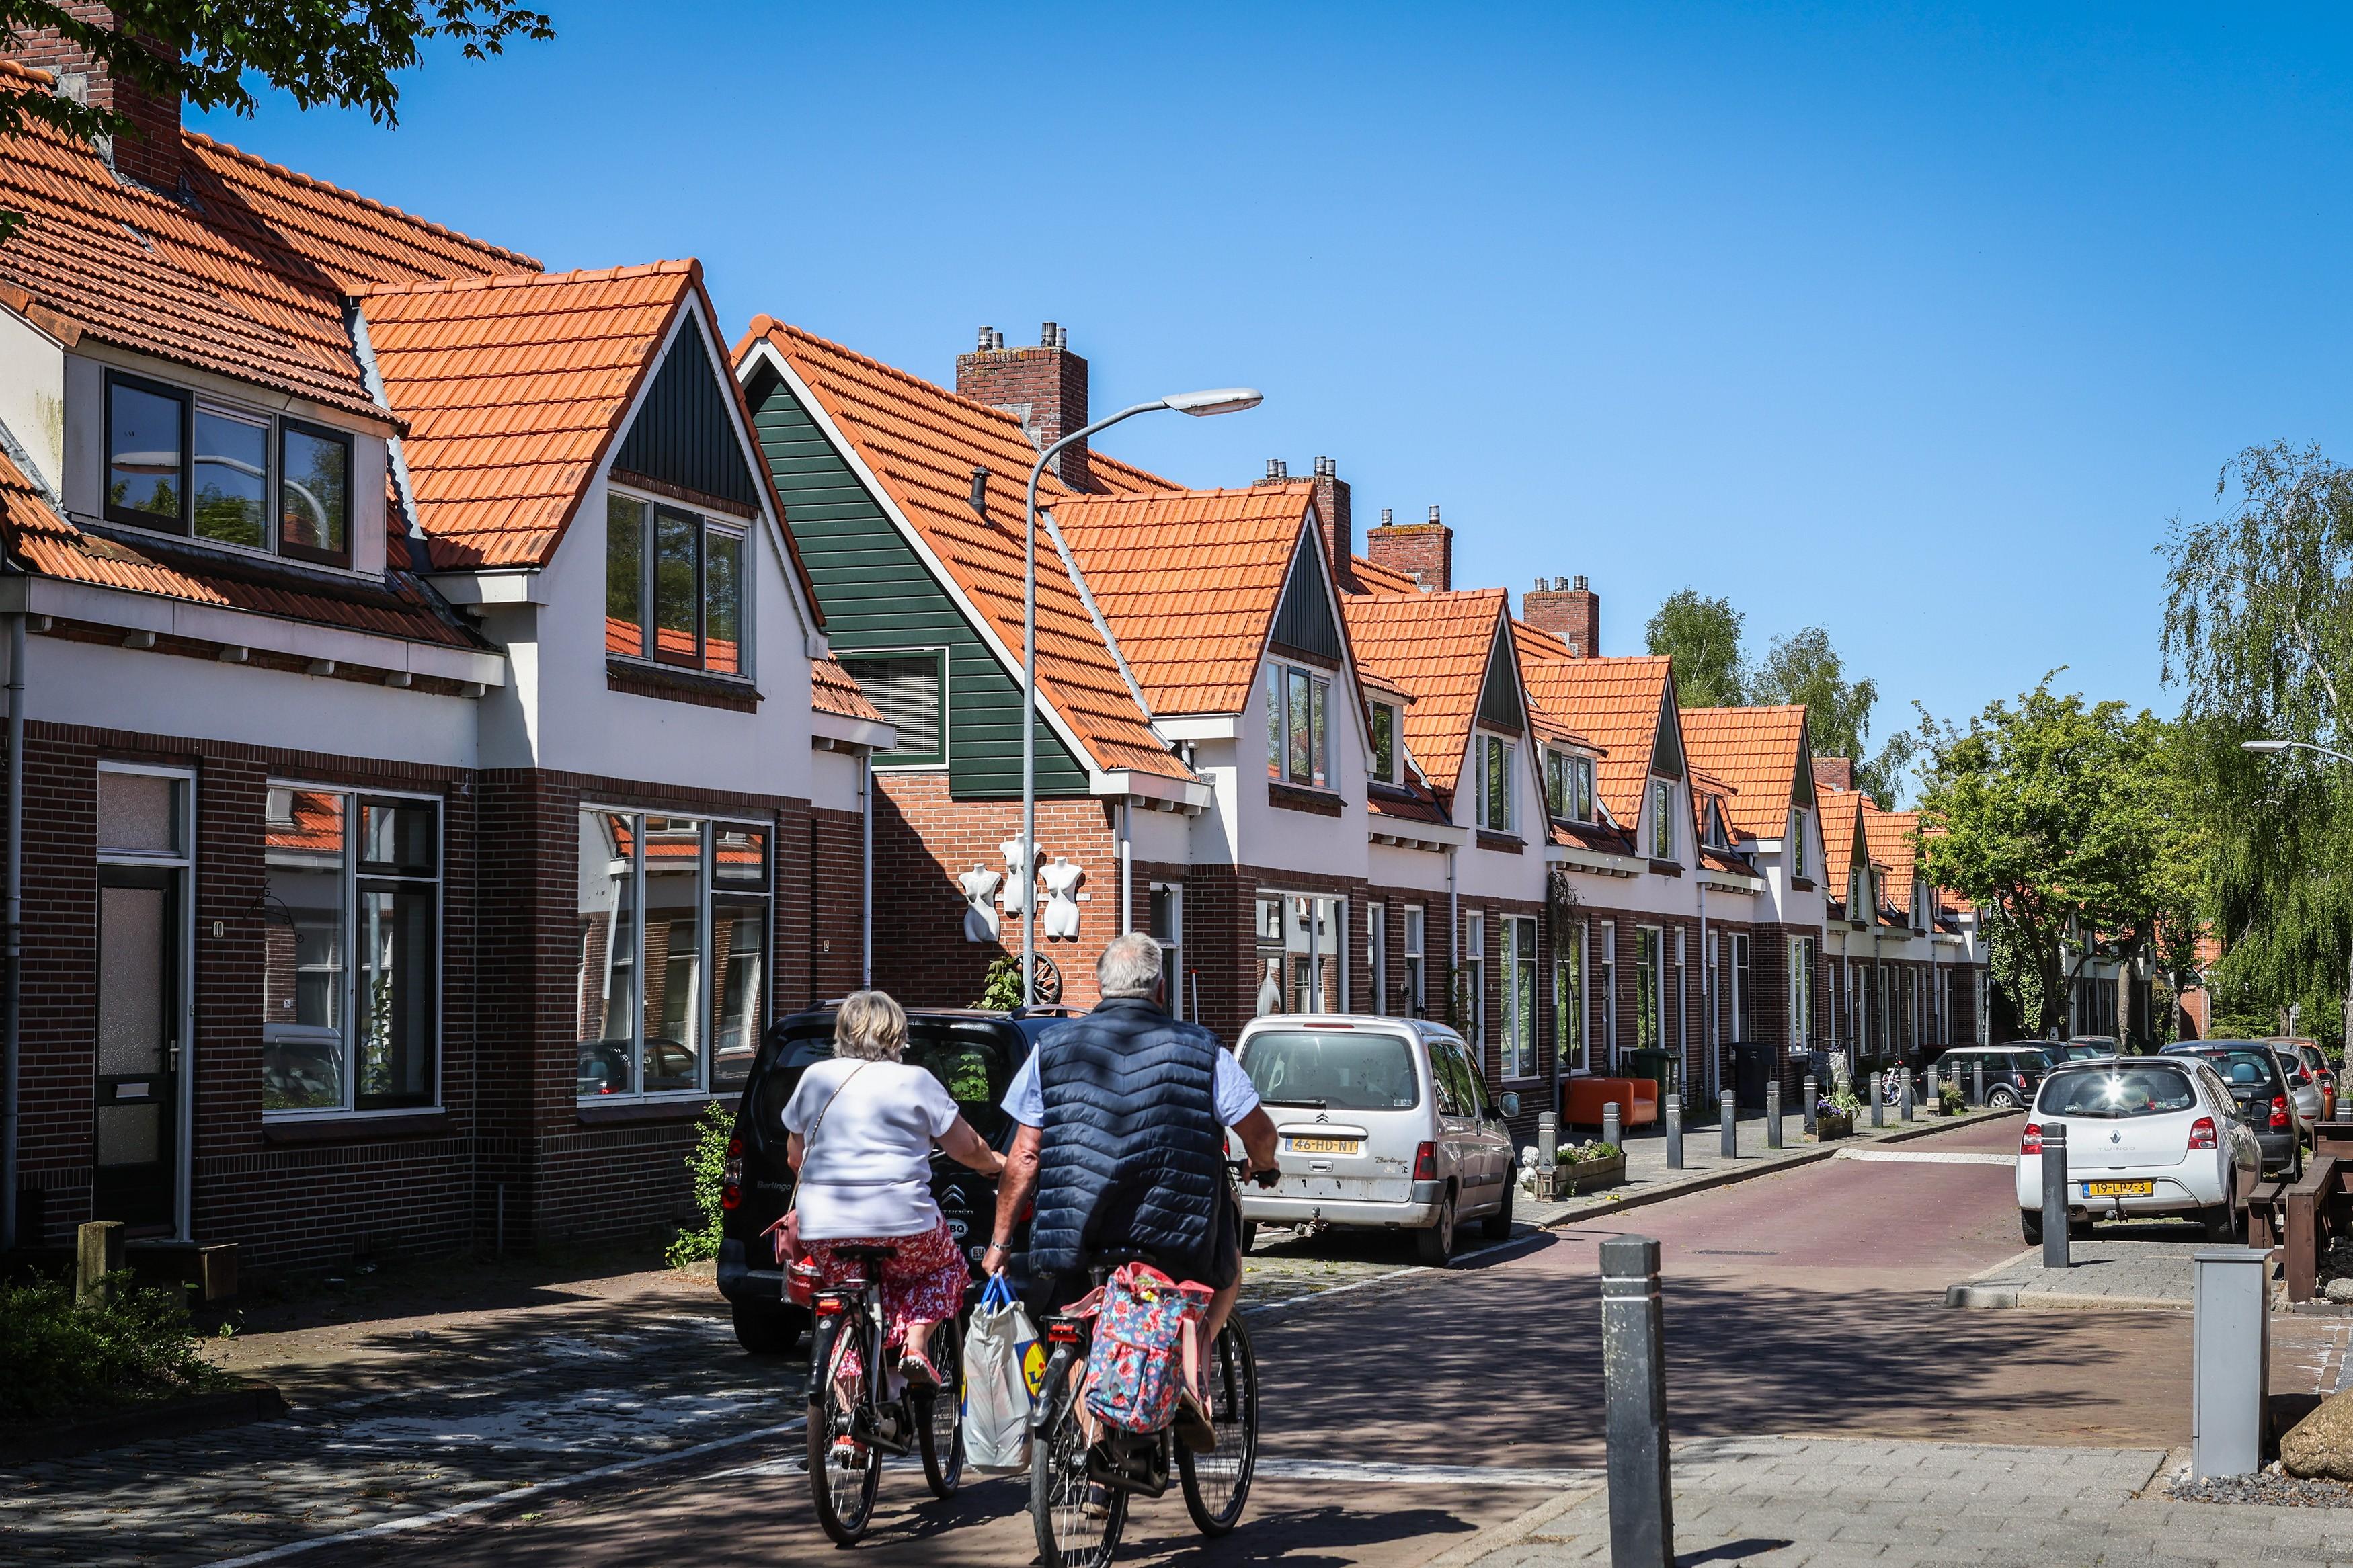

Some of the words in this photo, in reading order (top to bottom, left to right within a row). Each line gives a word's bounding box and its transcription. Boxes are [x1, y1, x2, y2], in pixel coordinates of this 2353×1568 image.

[1295, 1138, 1355, 1151] 46-HD-NT
[1375, 1156, 1408, 1166] Berlingo
[757, 1181, 792, 1192] Berlingo
[947, 1225, 965, 1233] BQ
[973, 1247, 984, 1255] EU
